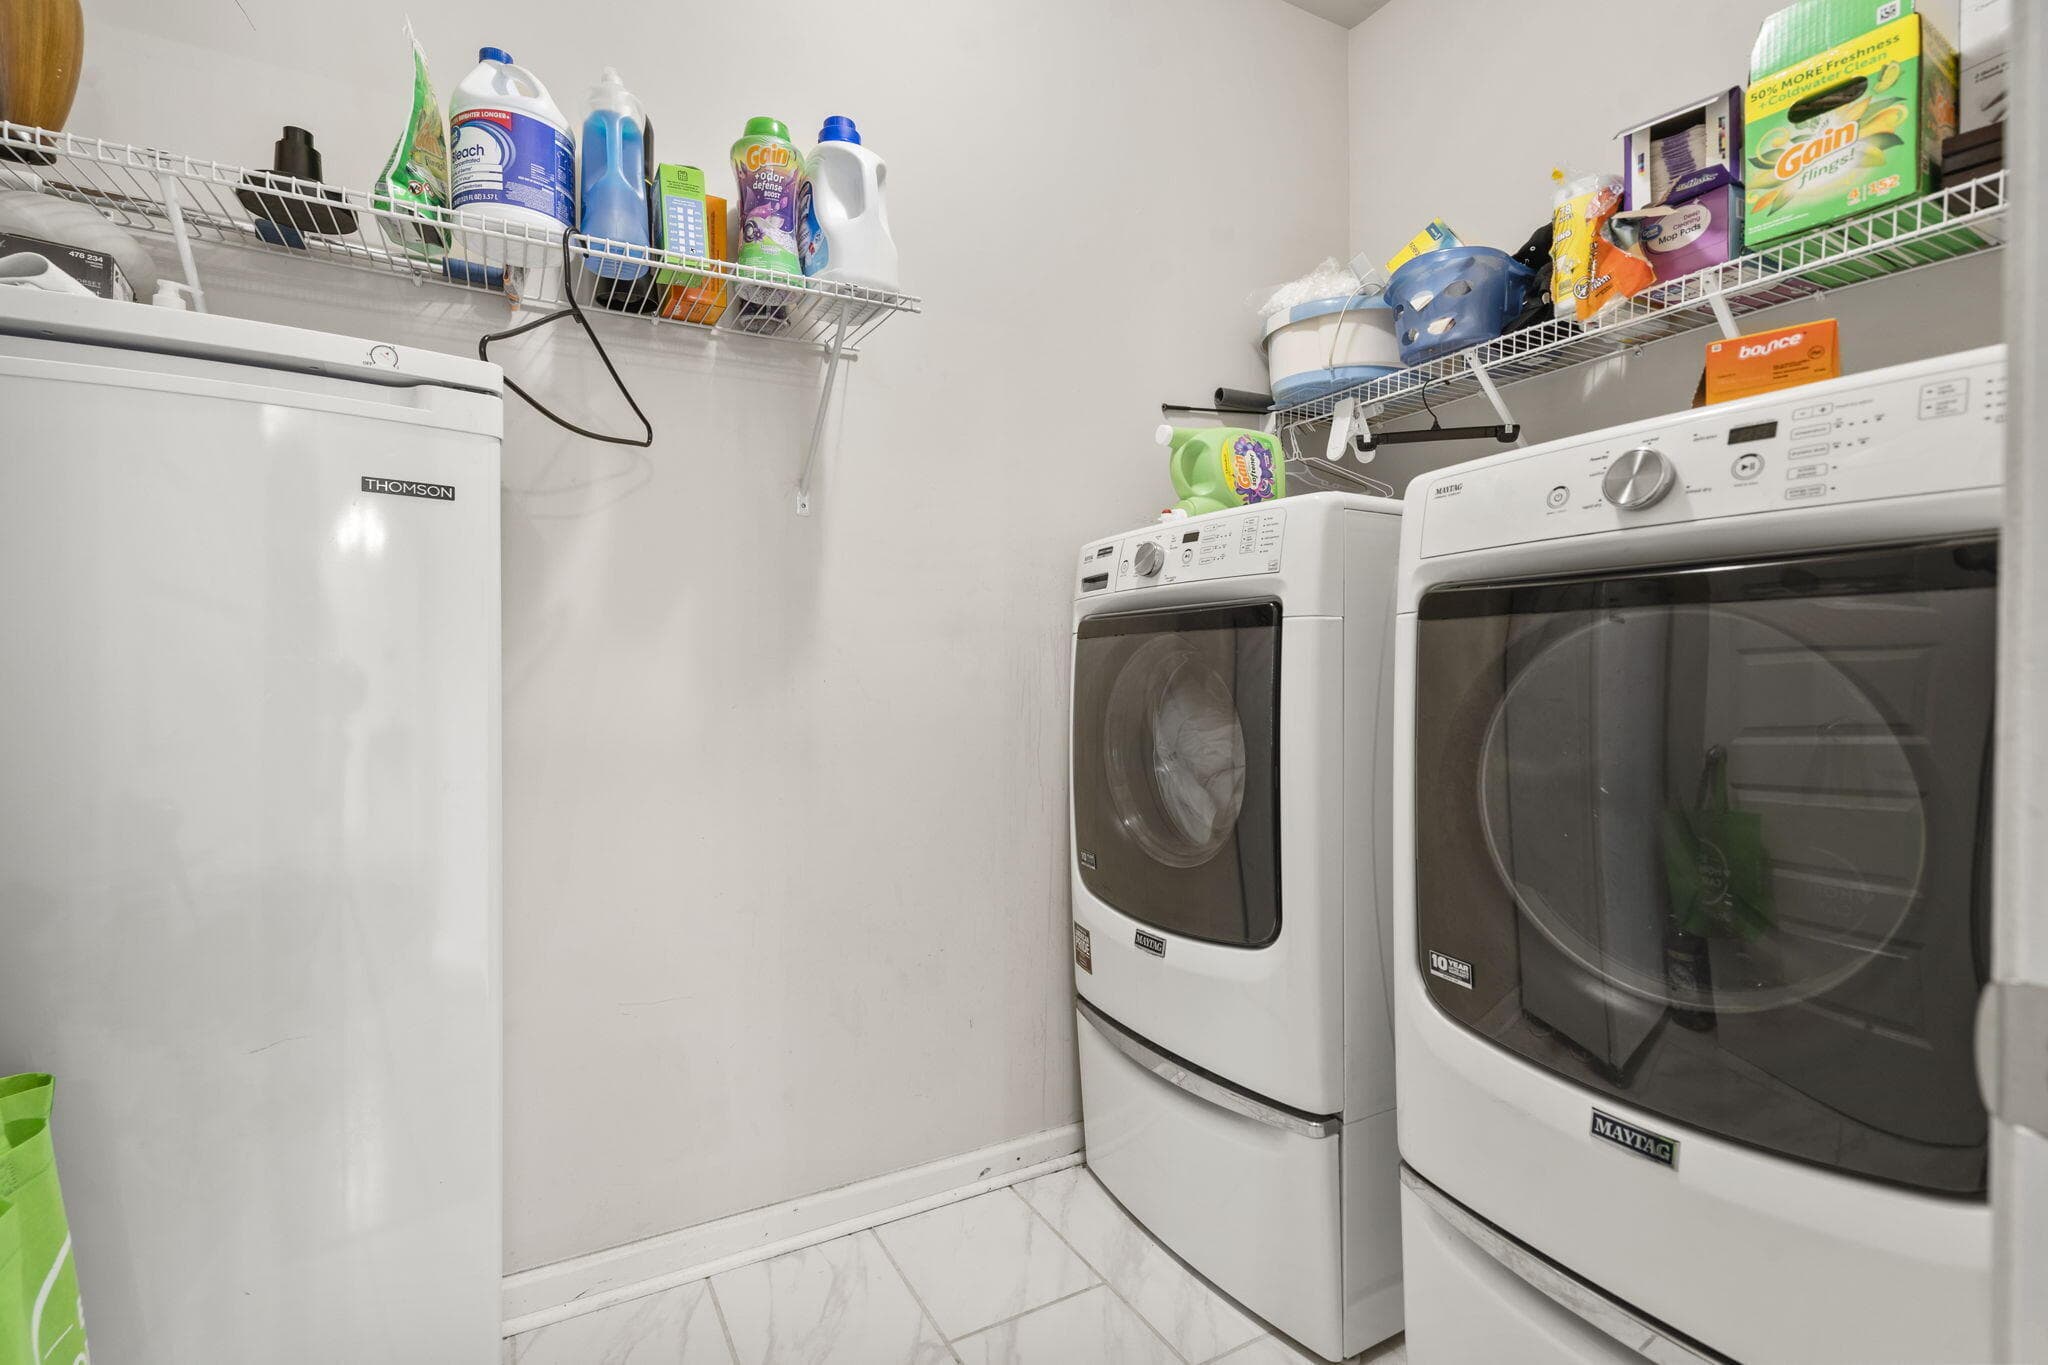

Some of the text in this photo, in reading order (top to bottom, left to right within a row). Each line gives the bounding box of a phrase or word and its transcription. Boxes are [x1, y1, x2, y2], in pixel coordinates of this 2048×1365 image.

[1750, 34, 1901, 103] 50% MORE Freshness
[1843, 51, 1888, 75] Clean
[452, 143, 485, 163] leach
[745, 143, 789, 172] Gain
[1775, 122, 1856, 180] Gain
[754, 170, 784, 183] +odor
[1798, 147, 1856, 190] flings!
[752, 181, 783, 193] defense
[1868, 175, 1901, 194] 152
[763, 190, 782, 200] BOOST
[1672, 216, 1701, 231] Cleaning
[1684, 210, 1701, 221] Deep
[1658, 223, 1701, 245] Mop Pads
[68, 250, 104, 263] 478 234
[1738, 332, 1804, 360] bounce
[1234, 455, 1252, 489] Gain
[1249, 453, 1259, 487] softener
[364, 478, 453, 499] THOMSON
[1435, 483, 1463, 496] MAYTAG
[1135, 933, 1163, 952] MAYTAG
[1431, 953, 1469, 972] 10 YEAR
[1594, 1116, 1671, 1161] MAYTAG
